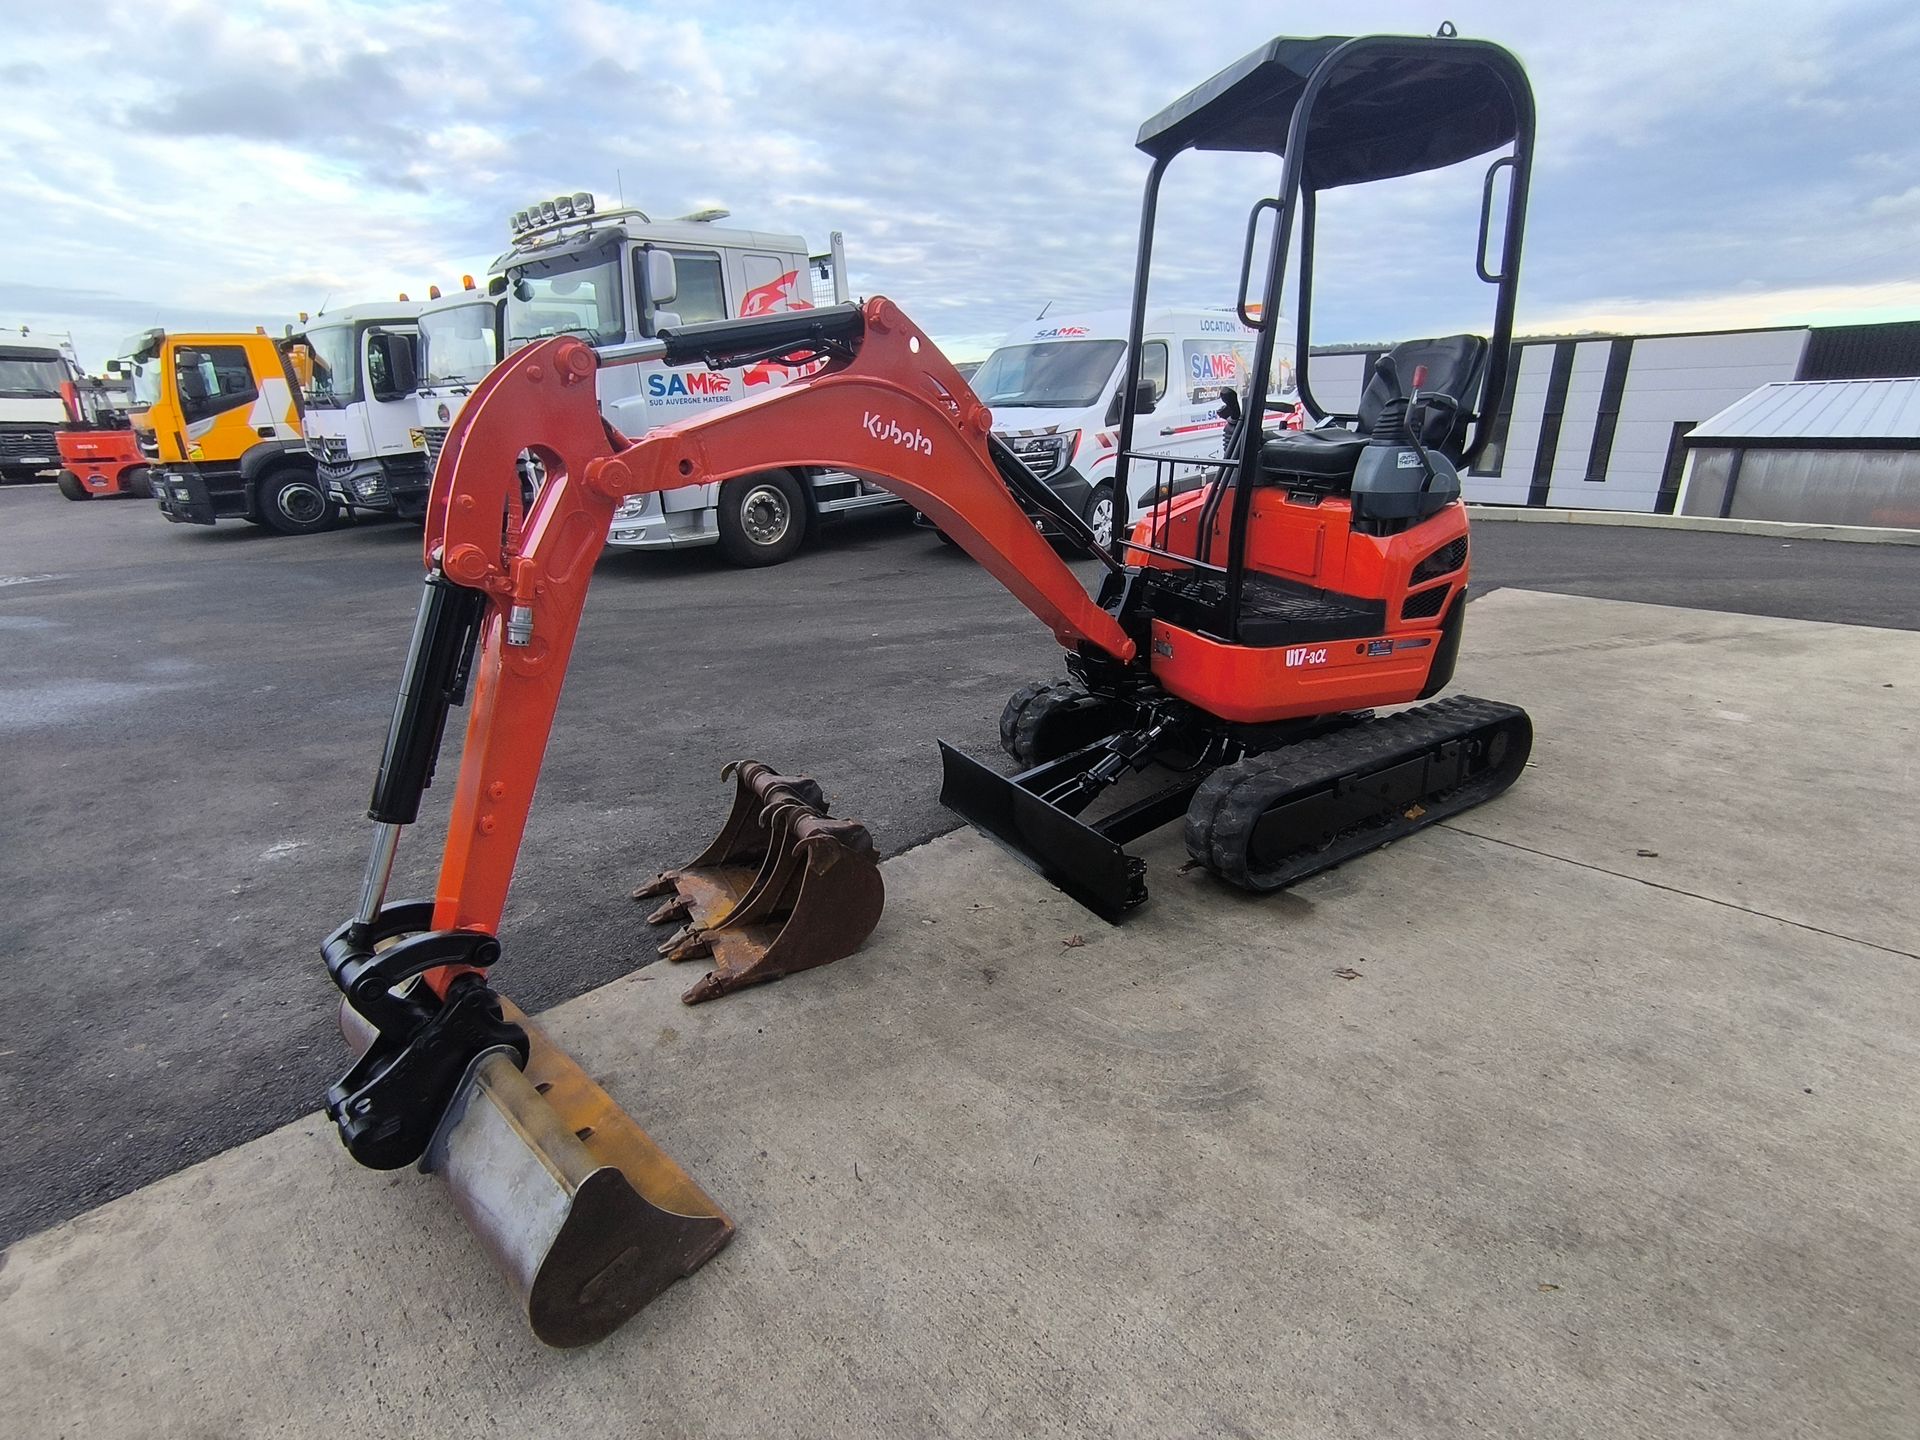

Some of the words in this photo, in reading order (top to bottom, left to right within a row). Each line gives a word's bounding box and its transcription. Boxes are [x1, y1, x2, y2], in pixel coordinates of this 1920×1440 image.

[1035, 327, 1074, 339] SAM
[1200, 320, 1236, 332] LOCATION
[1192, 355, 1223, 378] SAM
[648, 372, 708, 397] SAM
[665, 397, 701, 406] AUVERGNE
[702, 395, 733, 404] MATERIEL
[863, 411, 933, 456] Kubota
